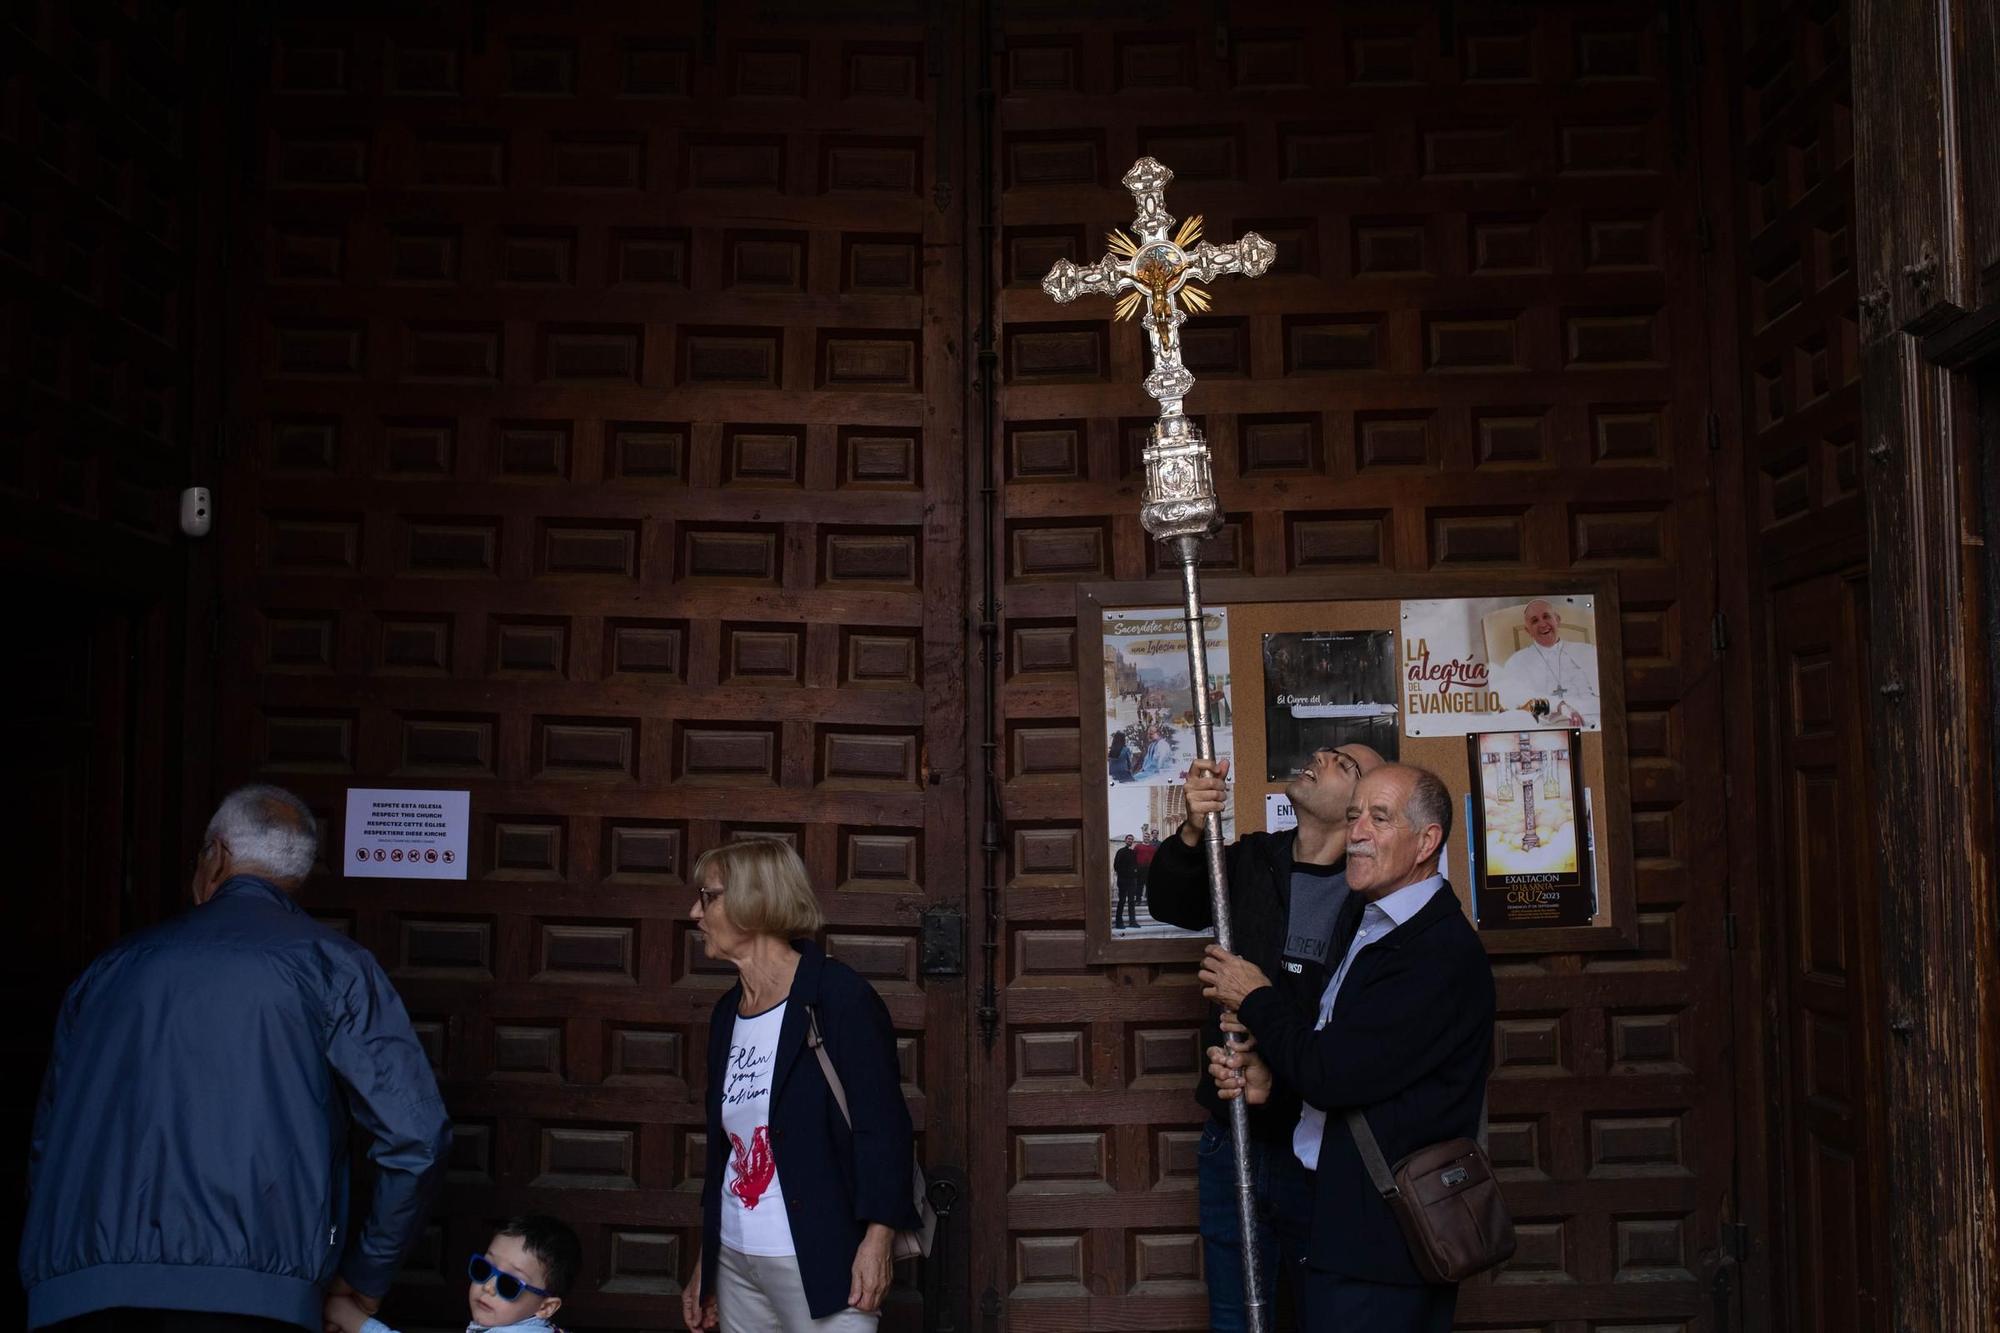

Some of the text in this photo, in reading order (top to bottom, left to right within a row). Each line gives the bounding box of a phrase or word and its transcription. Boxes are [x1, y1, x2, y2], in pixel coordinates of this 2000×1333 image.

[1406, 638, 1429, 661] LA
[1408, 651, 1489, 693] alegría
[1408, 682, 1422, 691] DEL
[1409, 691, 1500, 714] EVANGELIO
[1277, 805, 1293, 816] ENT
[1506, 890, 1548, 905] CRUZ
